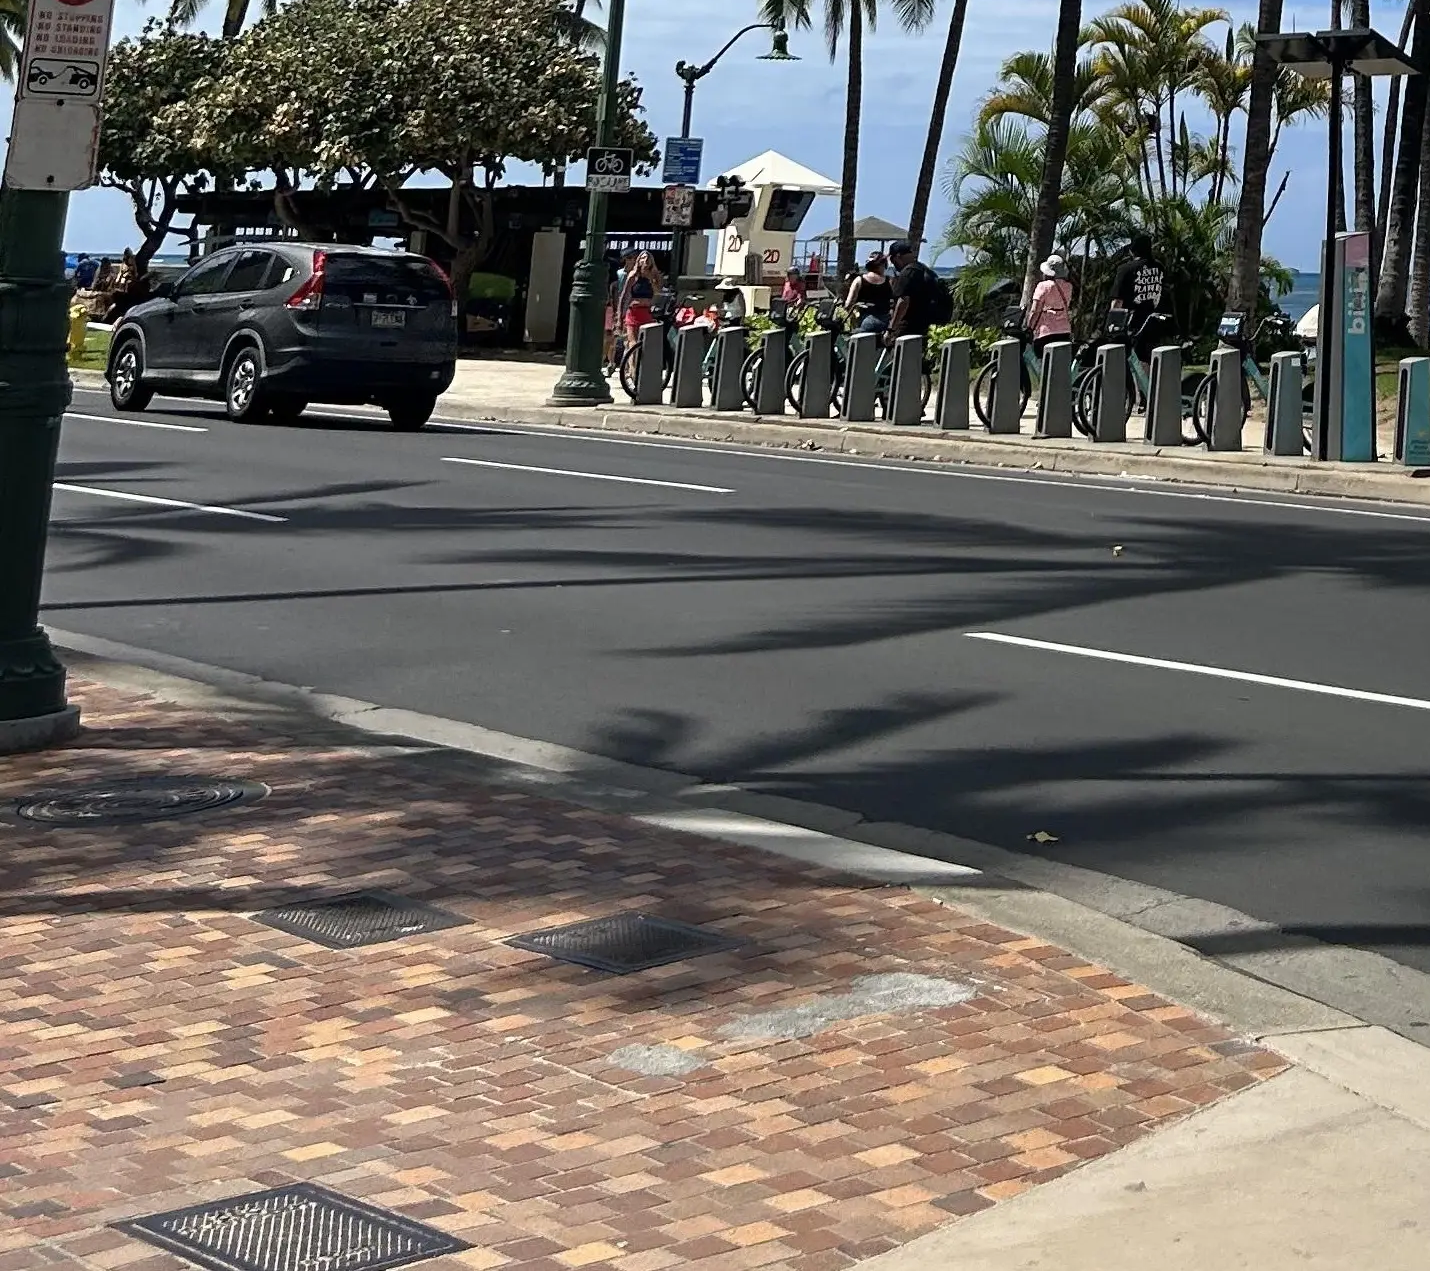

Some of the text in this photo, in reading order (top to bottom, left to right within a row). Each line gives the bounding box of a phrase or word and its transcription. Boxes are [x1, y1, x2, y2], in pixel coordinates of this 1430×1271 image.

[38, 10, 53, 20] NO
[37, 21, 103, 34] NO STANDING
[36, 33, 50, 42] NO
